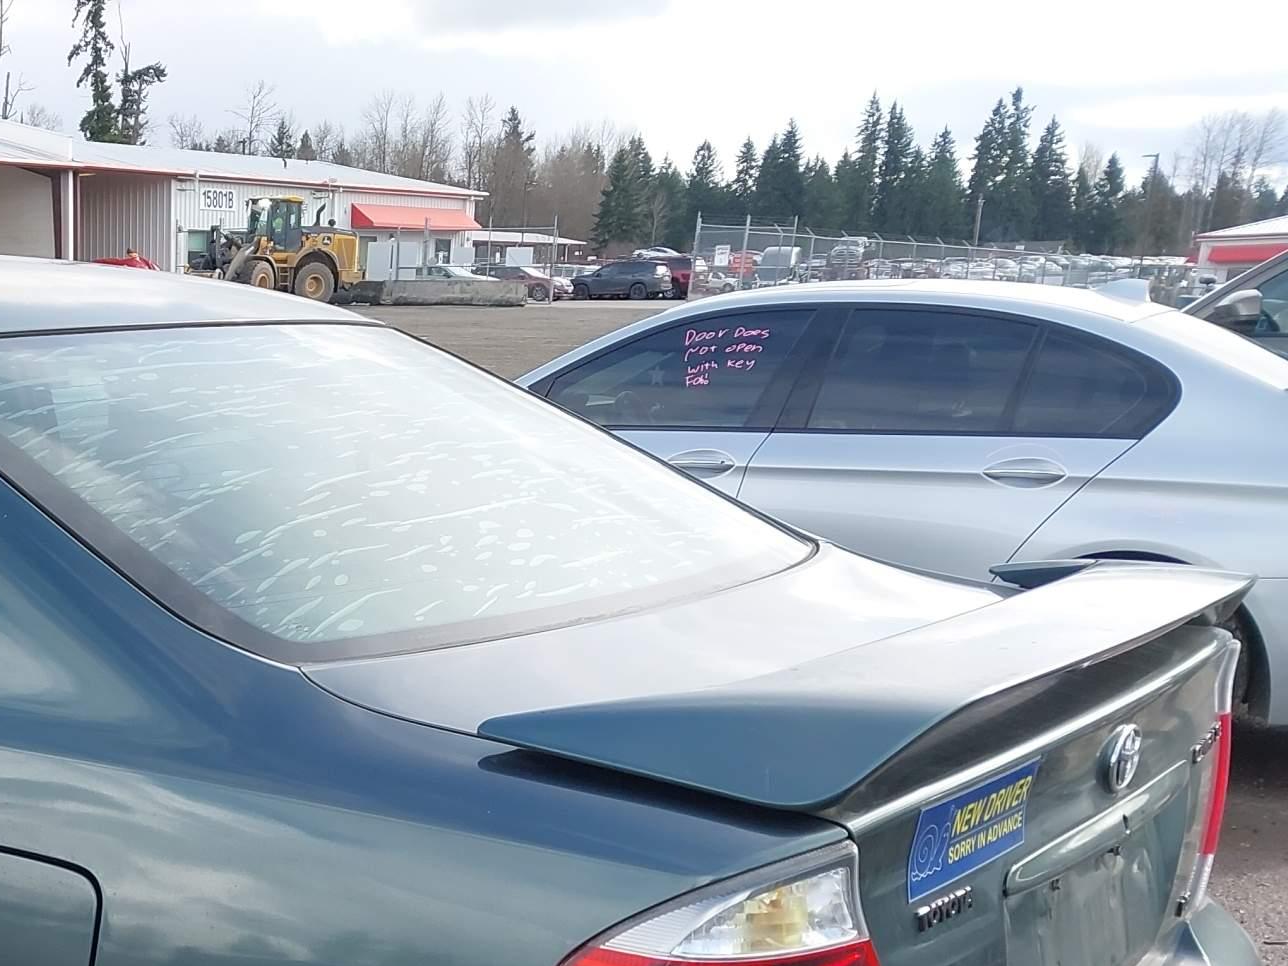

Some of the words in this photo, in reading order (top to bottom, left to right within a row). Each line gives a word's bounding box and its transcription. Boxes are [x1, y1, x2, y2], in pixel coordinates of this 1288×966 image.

[202, 189, 234, 209] 15801B
[951, 797, 988, 836] NEW
[983, 775, 1033, 823] DRIVER
[948, 838, 977, 866] SORRY
[977, 834, 987, 849] IN
[986, 809, 1024, 842] ADVANCE
